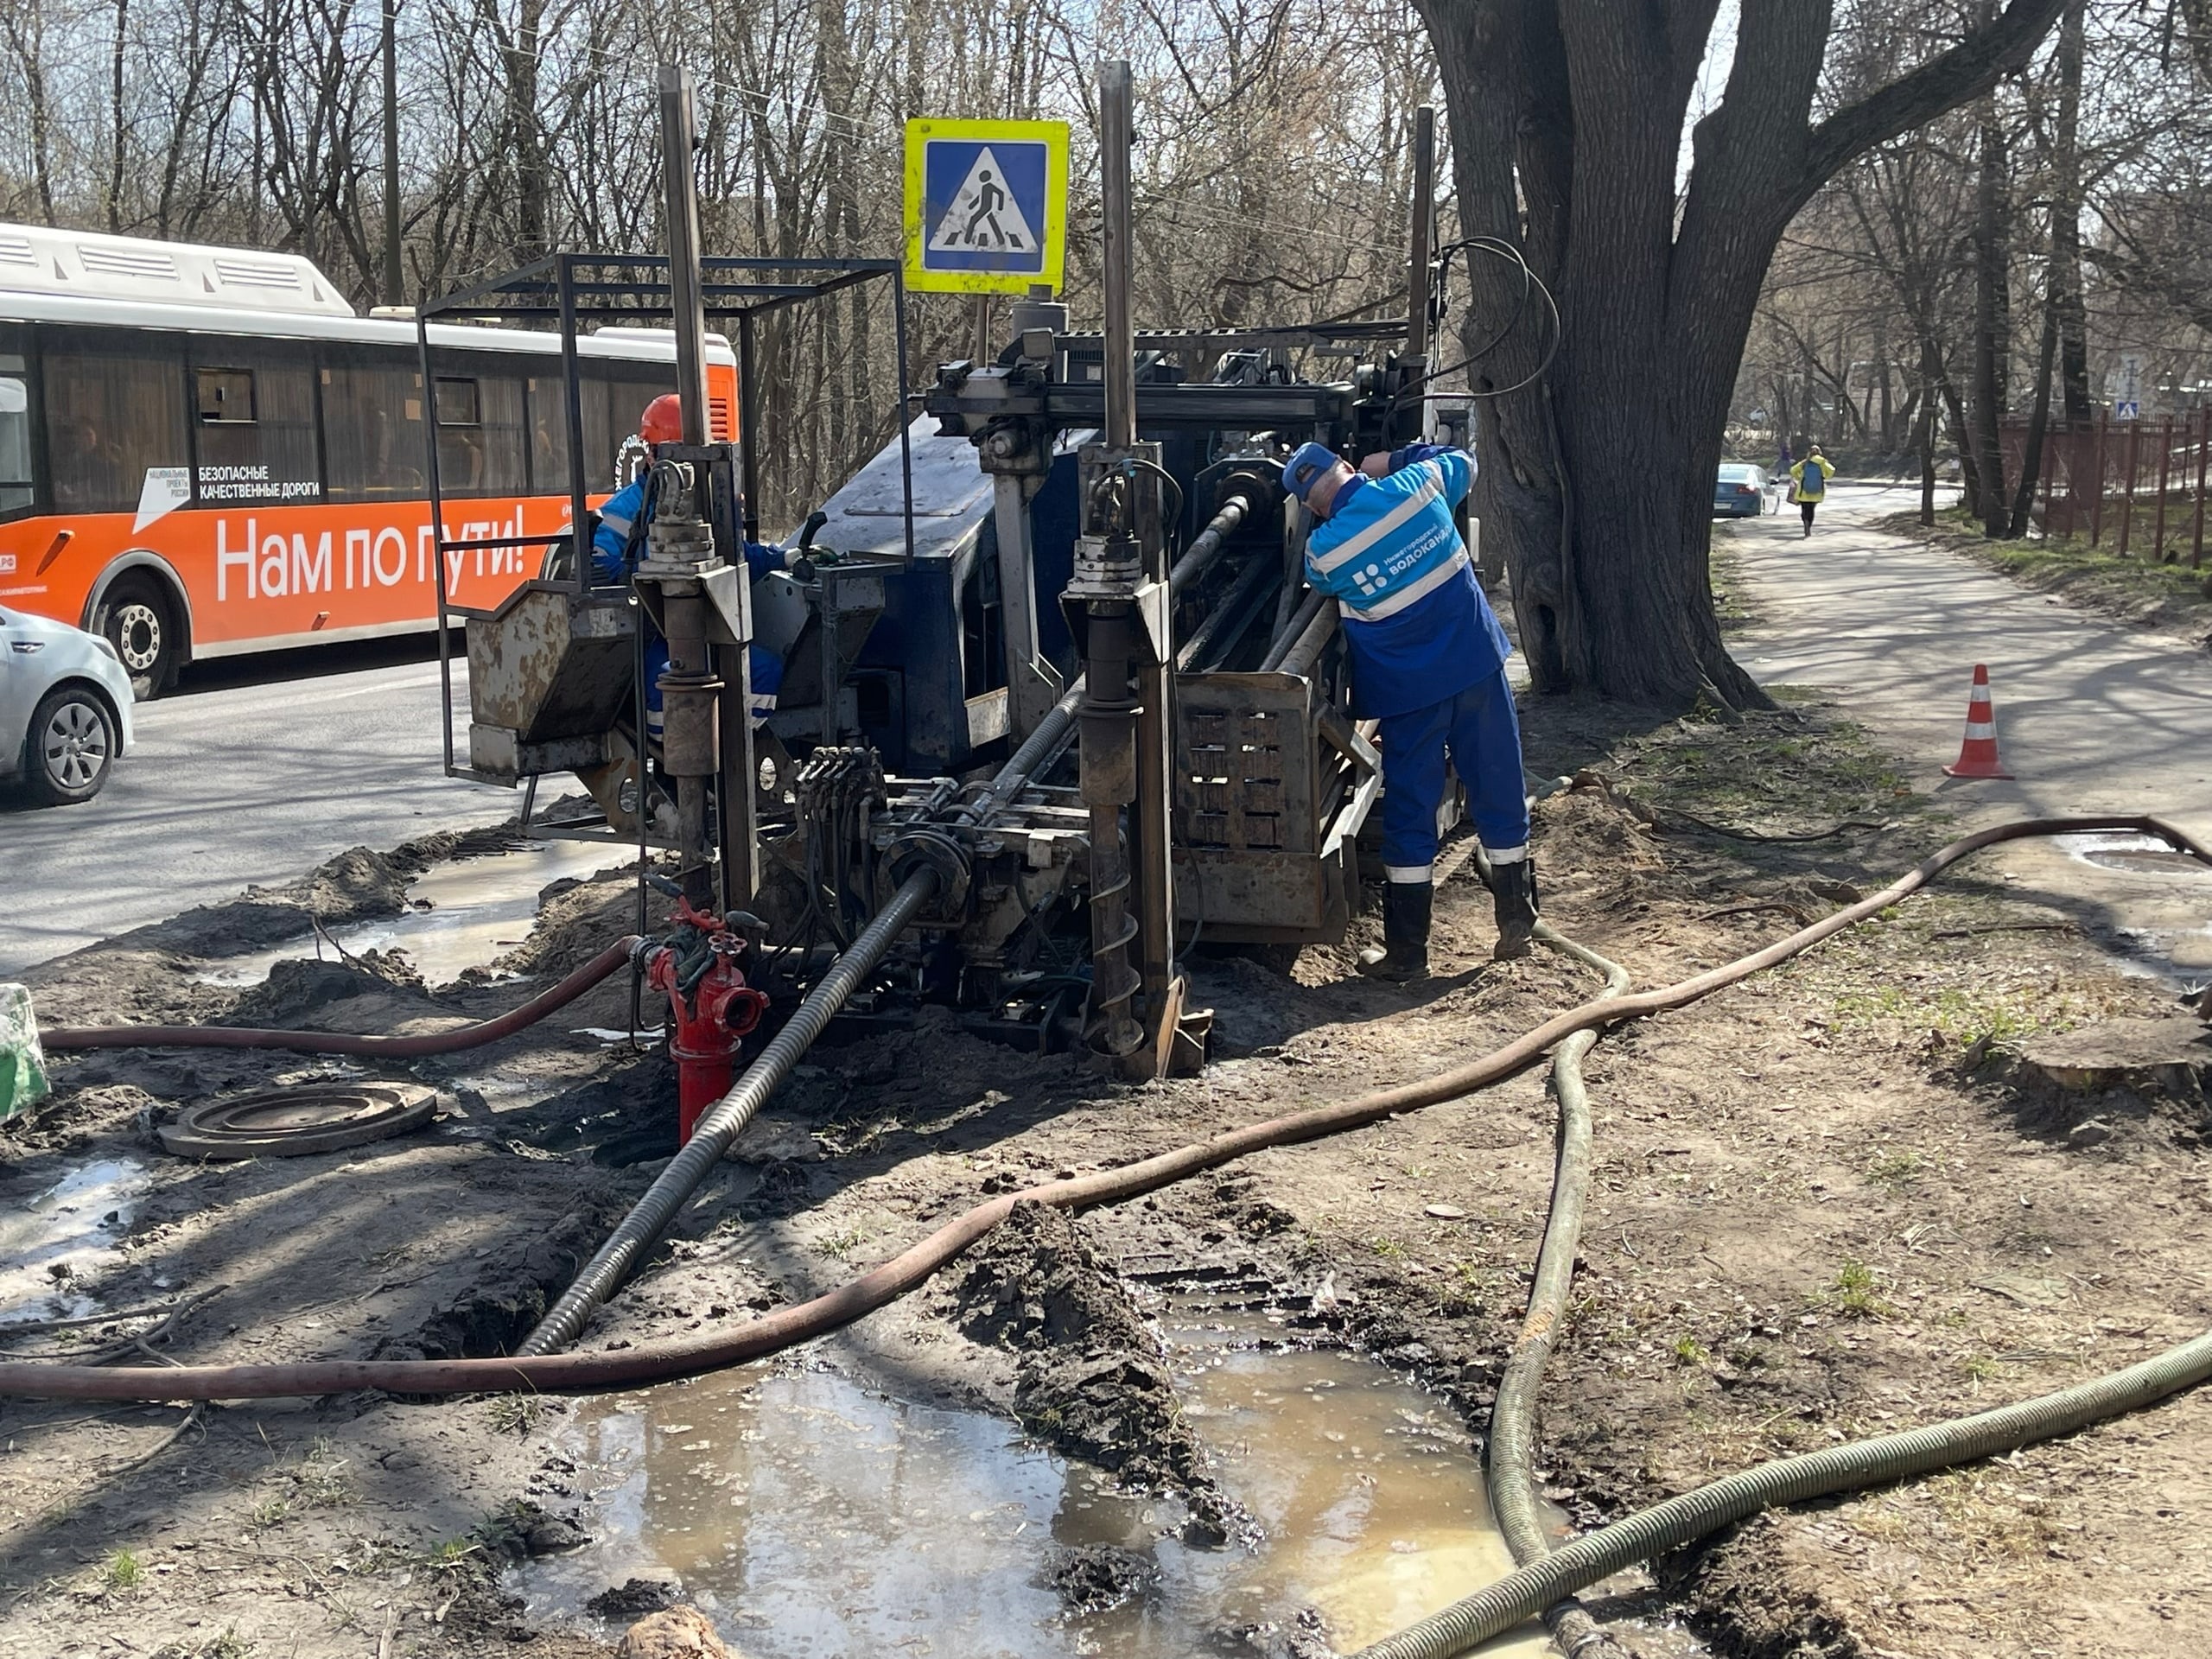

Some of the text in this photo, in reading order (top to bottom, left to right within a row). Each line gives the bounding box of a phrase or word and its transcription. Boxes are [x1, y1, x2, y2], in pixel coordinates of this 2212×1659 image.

[198, 466, 269, 481] БЕЗОПАСНЫЕ
[200, 482, 320, 499] КАЧЕСТВЕННЫЕ ДОРОГИ
[217, 505, 524, 602] Нам по пути!
